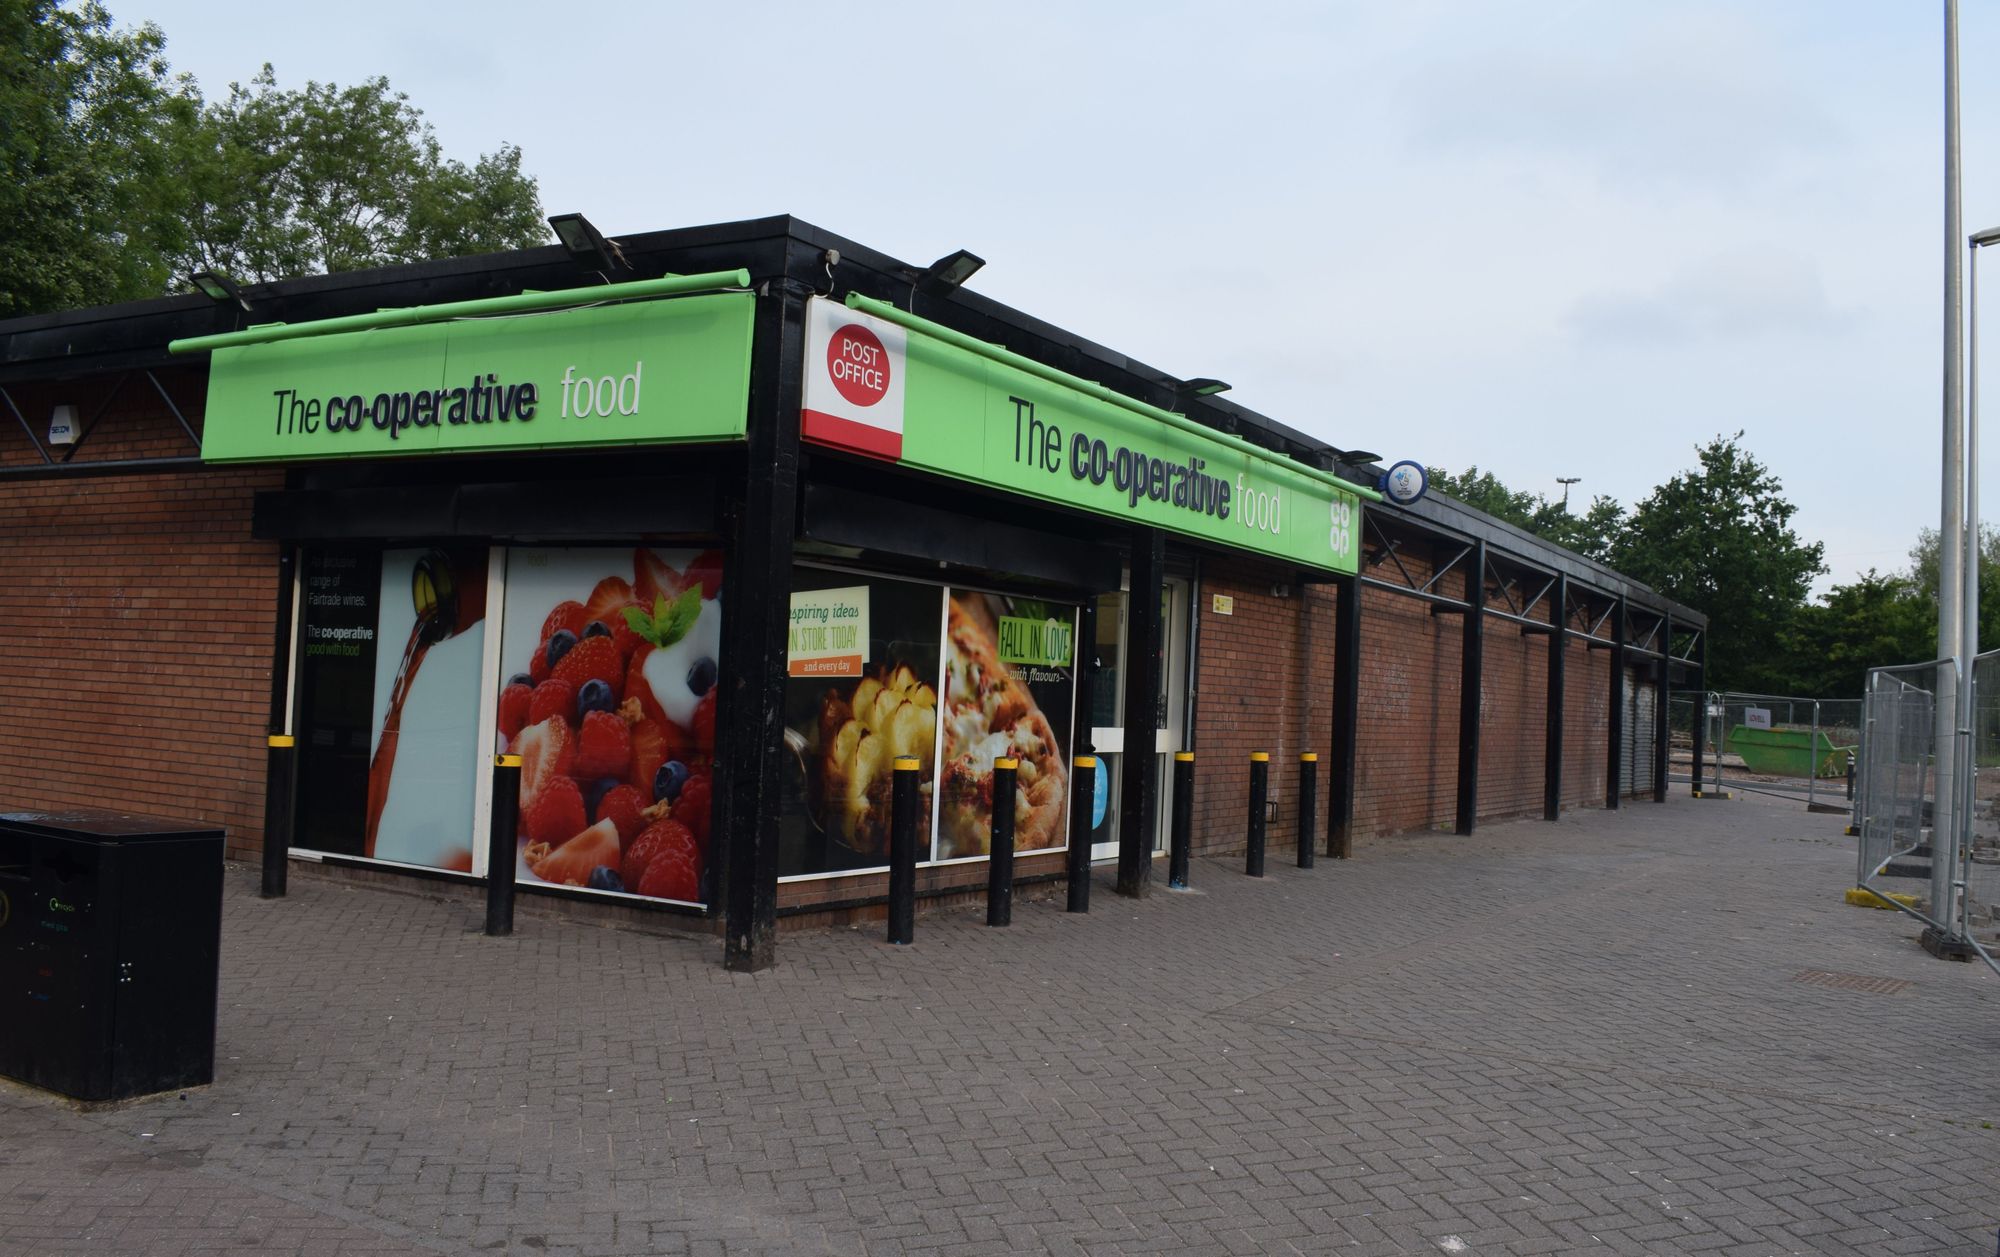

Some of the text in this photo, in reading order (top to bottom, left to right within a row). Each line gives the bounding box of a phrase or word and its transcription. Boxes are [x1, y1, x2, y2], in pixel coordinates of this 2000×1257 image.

[842, 338, 879, 367] POST
[833, 359, 883, 391] OFFICE
[274, 361, 643, 439] The co-operative food
[1008, 395, 1281, 535] The co-operative food
[308, 592, 367, 607] Fairtrade wines.
[790, 602, 859, 624] spiring ideas
[307, 625, 373, 641] The co-operative
[801, 626, 828, 651] STORE
[830, 624, 858, 650] TODAY
[1000, 621, 1069, 661] FALL IN LOVE
[804, 661, 818, 672] and
